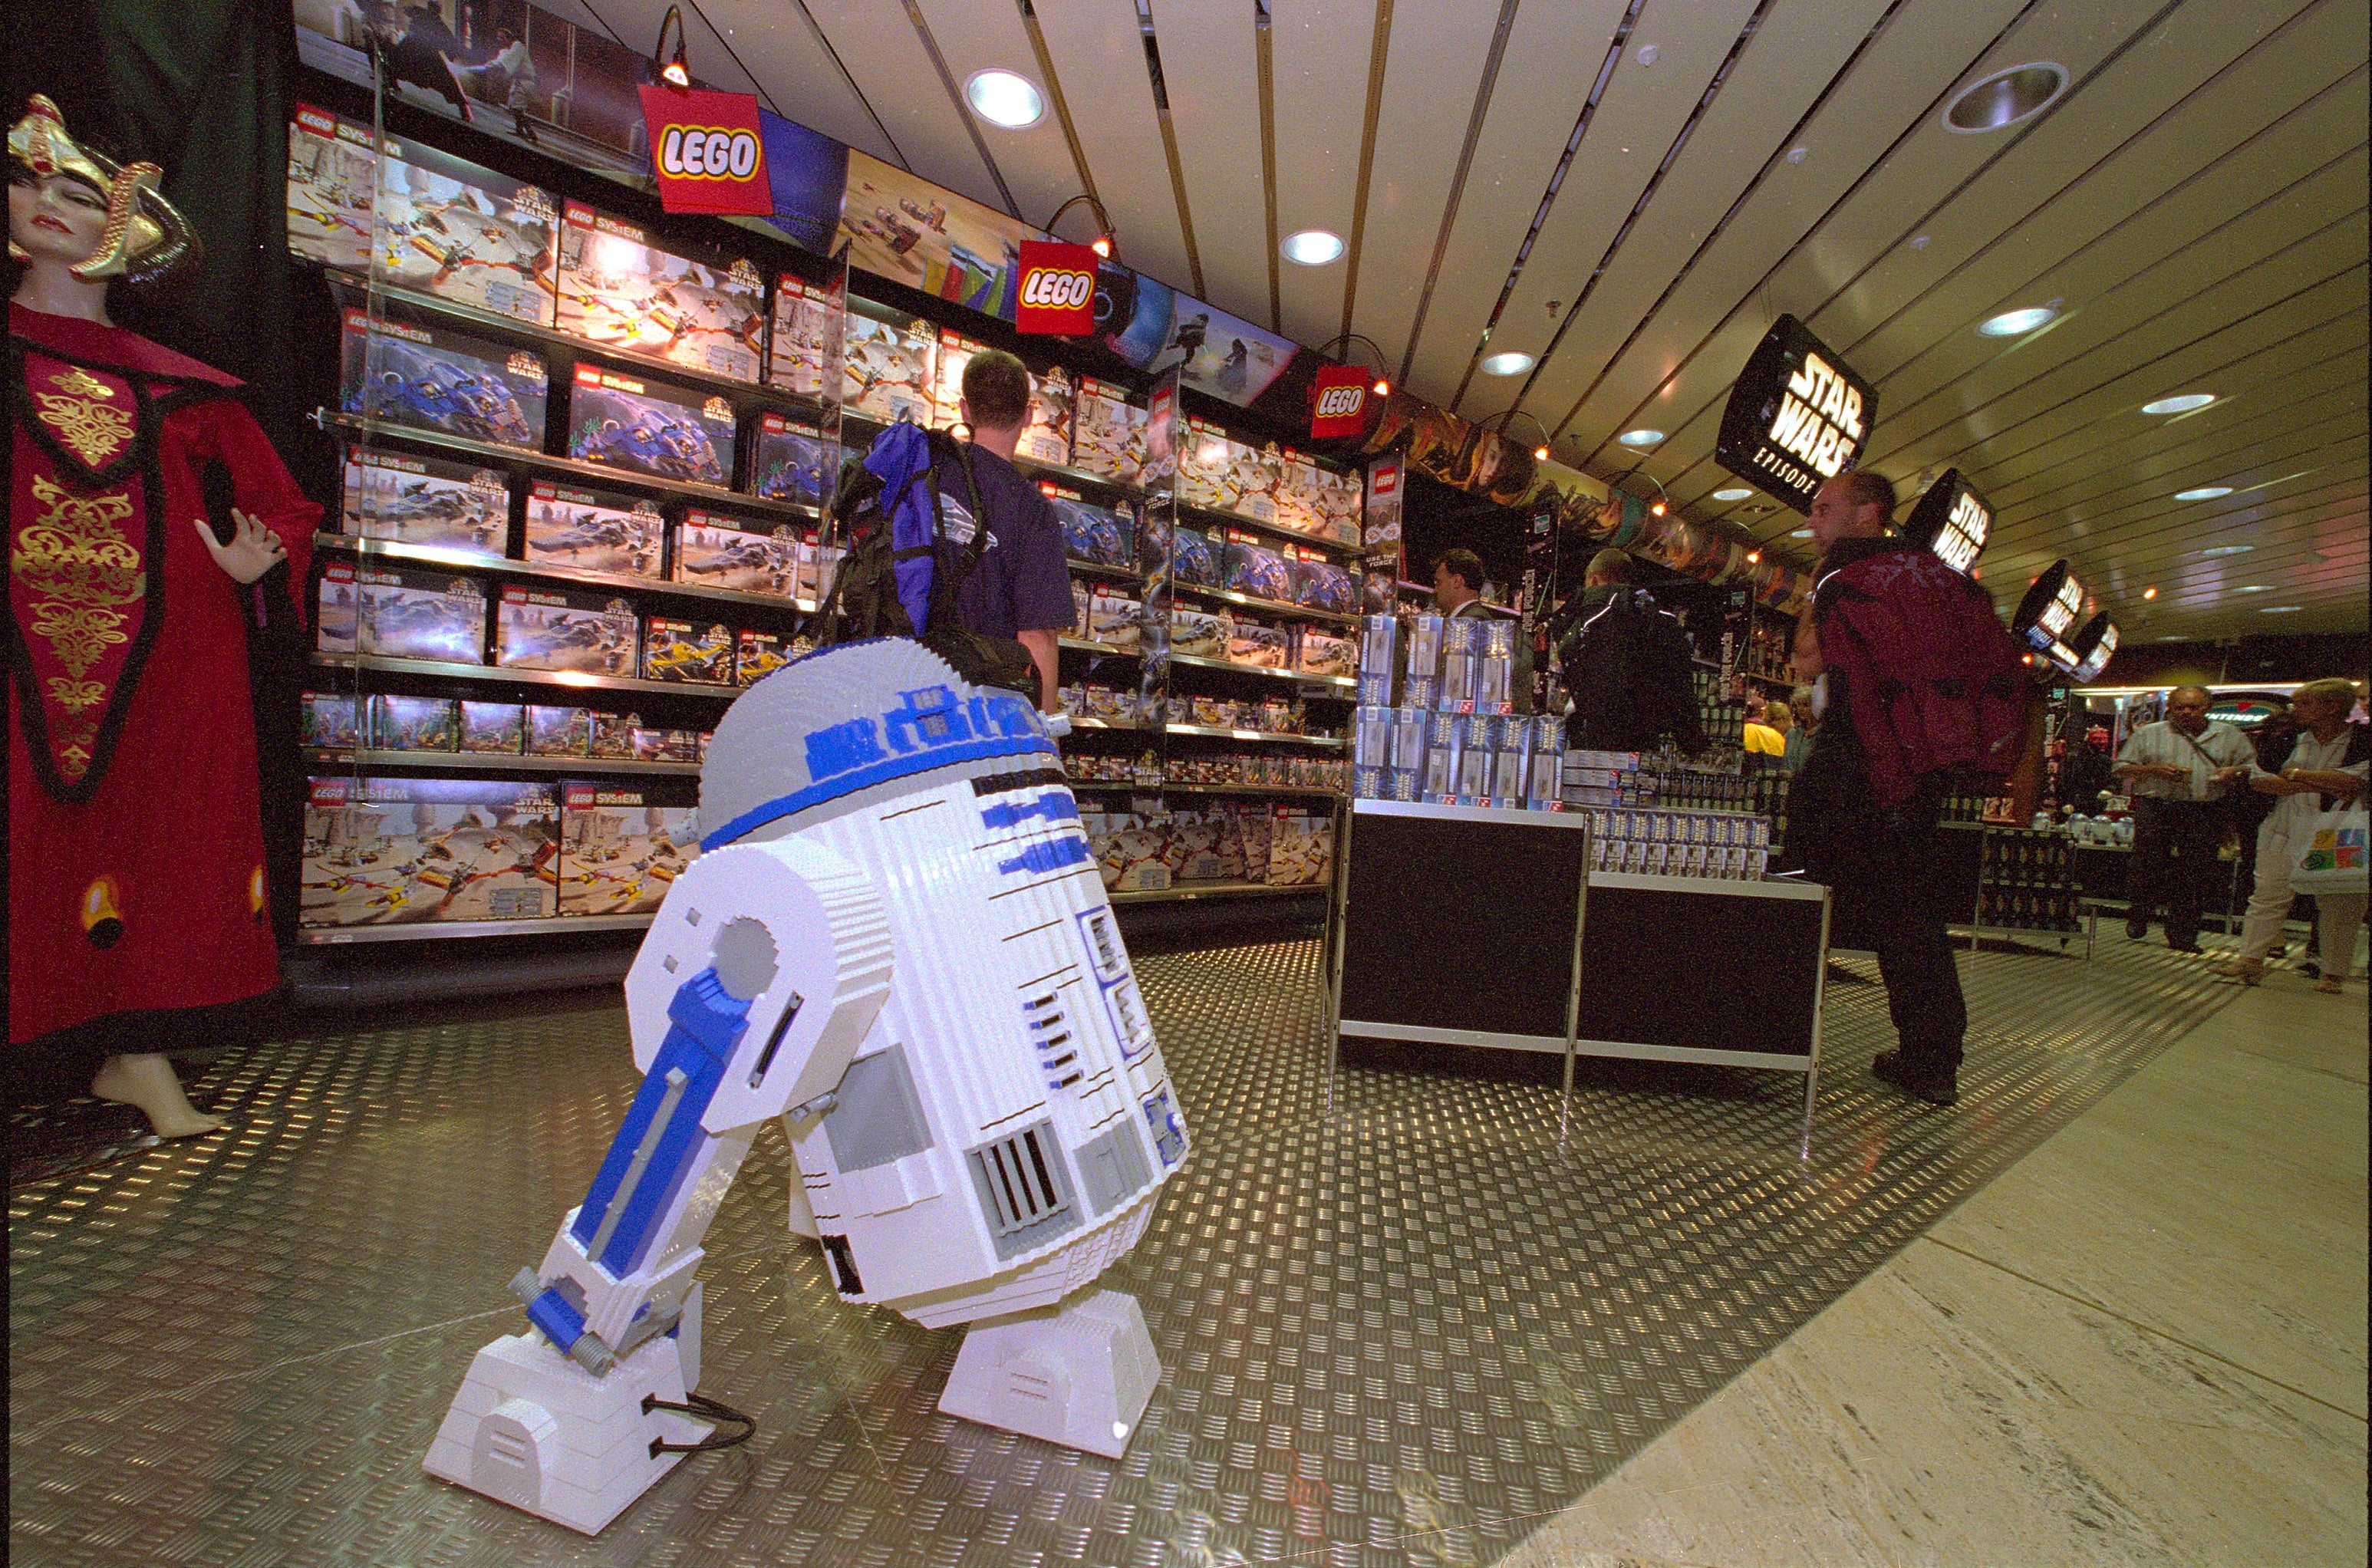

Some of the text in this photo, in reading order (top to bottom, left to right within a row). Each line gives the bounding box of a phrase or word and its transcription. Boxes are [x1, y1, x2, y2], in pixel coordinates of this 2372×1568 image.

[298, 110, 404, 157] LEGO SYSTM
[664, 129, 756, 176] LEGO
[513, 196, 555, 215] STAR
[514, 204, 558, 223] WARS
[567, 209, 594, 225] LEGO
[728, 268, 762, 283] STAR
[730, 275, 763, 291] WARS
[1025, 272, 1092, 307] LEGO
[507, 361, 544, 374] STAR
[508, 367, 542, 381] WARS
[576, 371, 601, 384] LEGO
[1317, 388, 1363, 416] LEGO
[1788, 351, 1863, 440] STAR
[1769, 391, 1856, 479] WARS
[1752, 446, 1817, 494] EPISODE
[1376, 474, 1395, 487] LEGO
[1949, 492, 1989, 546] STAR
[1932, 521, 1980, 572] WARS
[328, 568, 353, 579] LEGO
[2204, 713, 2265, 722] INTENDO
[313, 786, 344, 799] LEGO
[570, 793, 643, 805] LEGO SYSTEM
[515, 797, 555, 807] STAR
[515, 805, 558, 815] WARS
